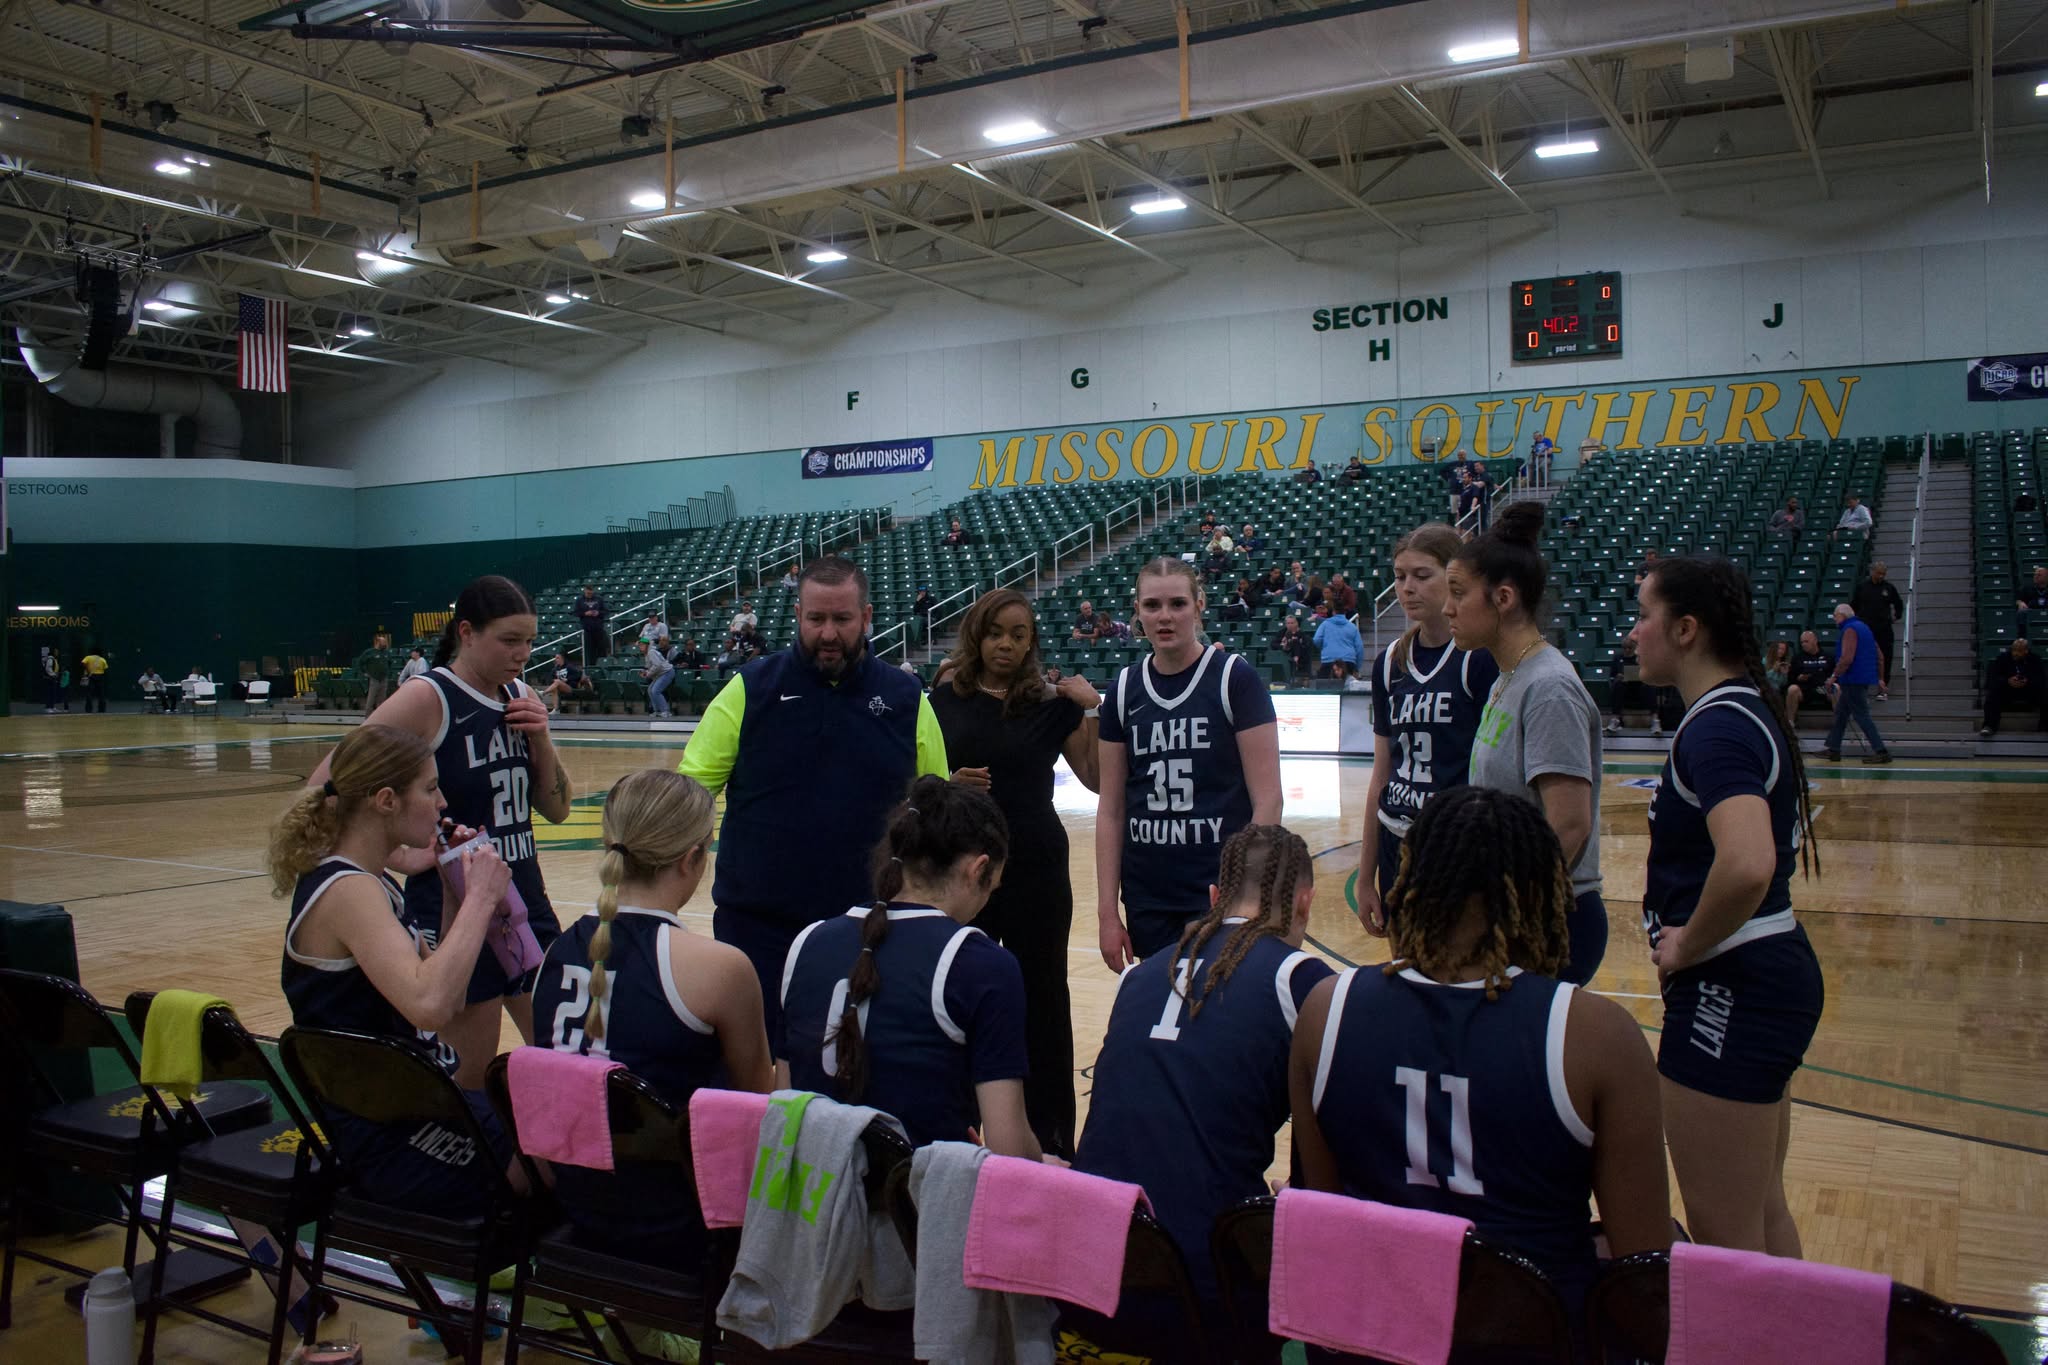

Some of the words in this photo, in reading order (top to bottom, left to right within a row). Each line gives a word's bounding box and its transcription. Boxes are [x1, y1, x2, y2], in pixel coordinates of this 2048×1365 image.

[1312, 297, 1449, 332] SECTION
[1762, 302, 1783, 329] J
[1369, 338, 1390, 362] H
[1070, 367, 1090, 389] G
[847, 391, 860, 411] F
[968, 412, 1326, 490] MISSOURI
[1358, 375, 1861, 465] SOUTHERN
[834, 446, 926, 472] CHAMPIONSHIPS
[8, 483, 89, 495] ESTROOMS
[1388, 691, 1454, 726] LAKE
[1131, 716, 1212, 756] LAKE
[1396, 731, 1433, 784] 12
[489, 766, 530, 828] 20
[1146, 758, 1194, 812] 35
[1129, 816, 1224, 845] COUNTY
[552, 964, 617, 1058] 21
[1149, 957, 1205, 1042] 1
[1394, 1065, 1485, 1196] 11
